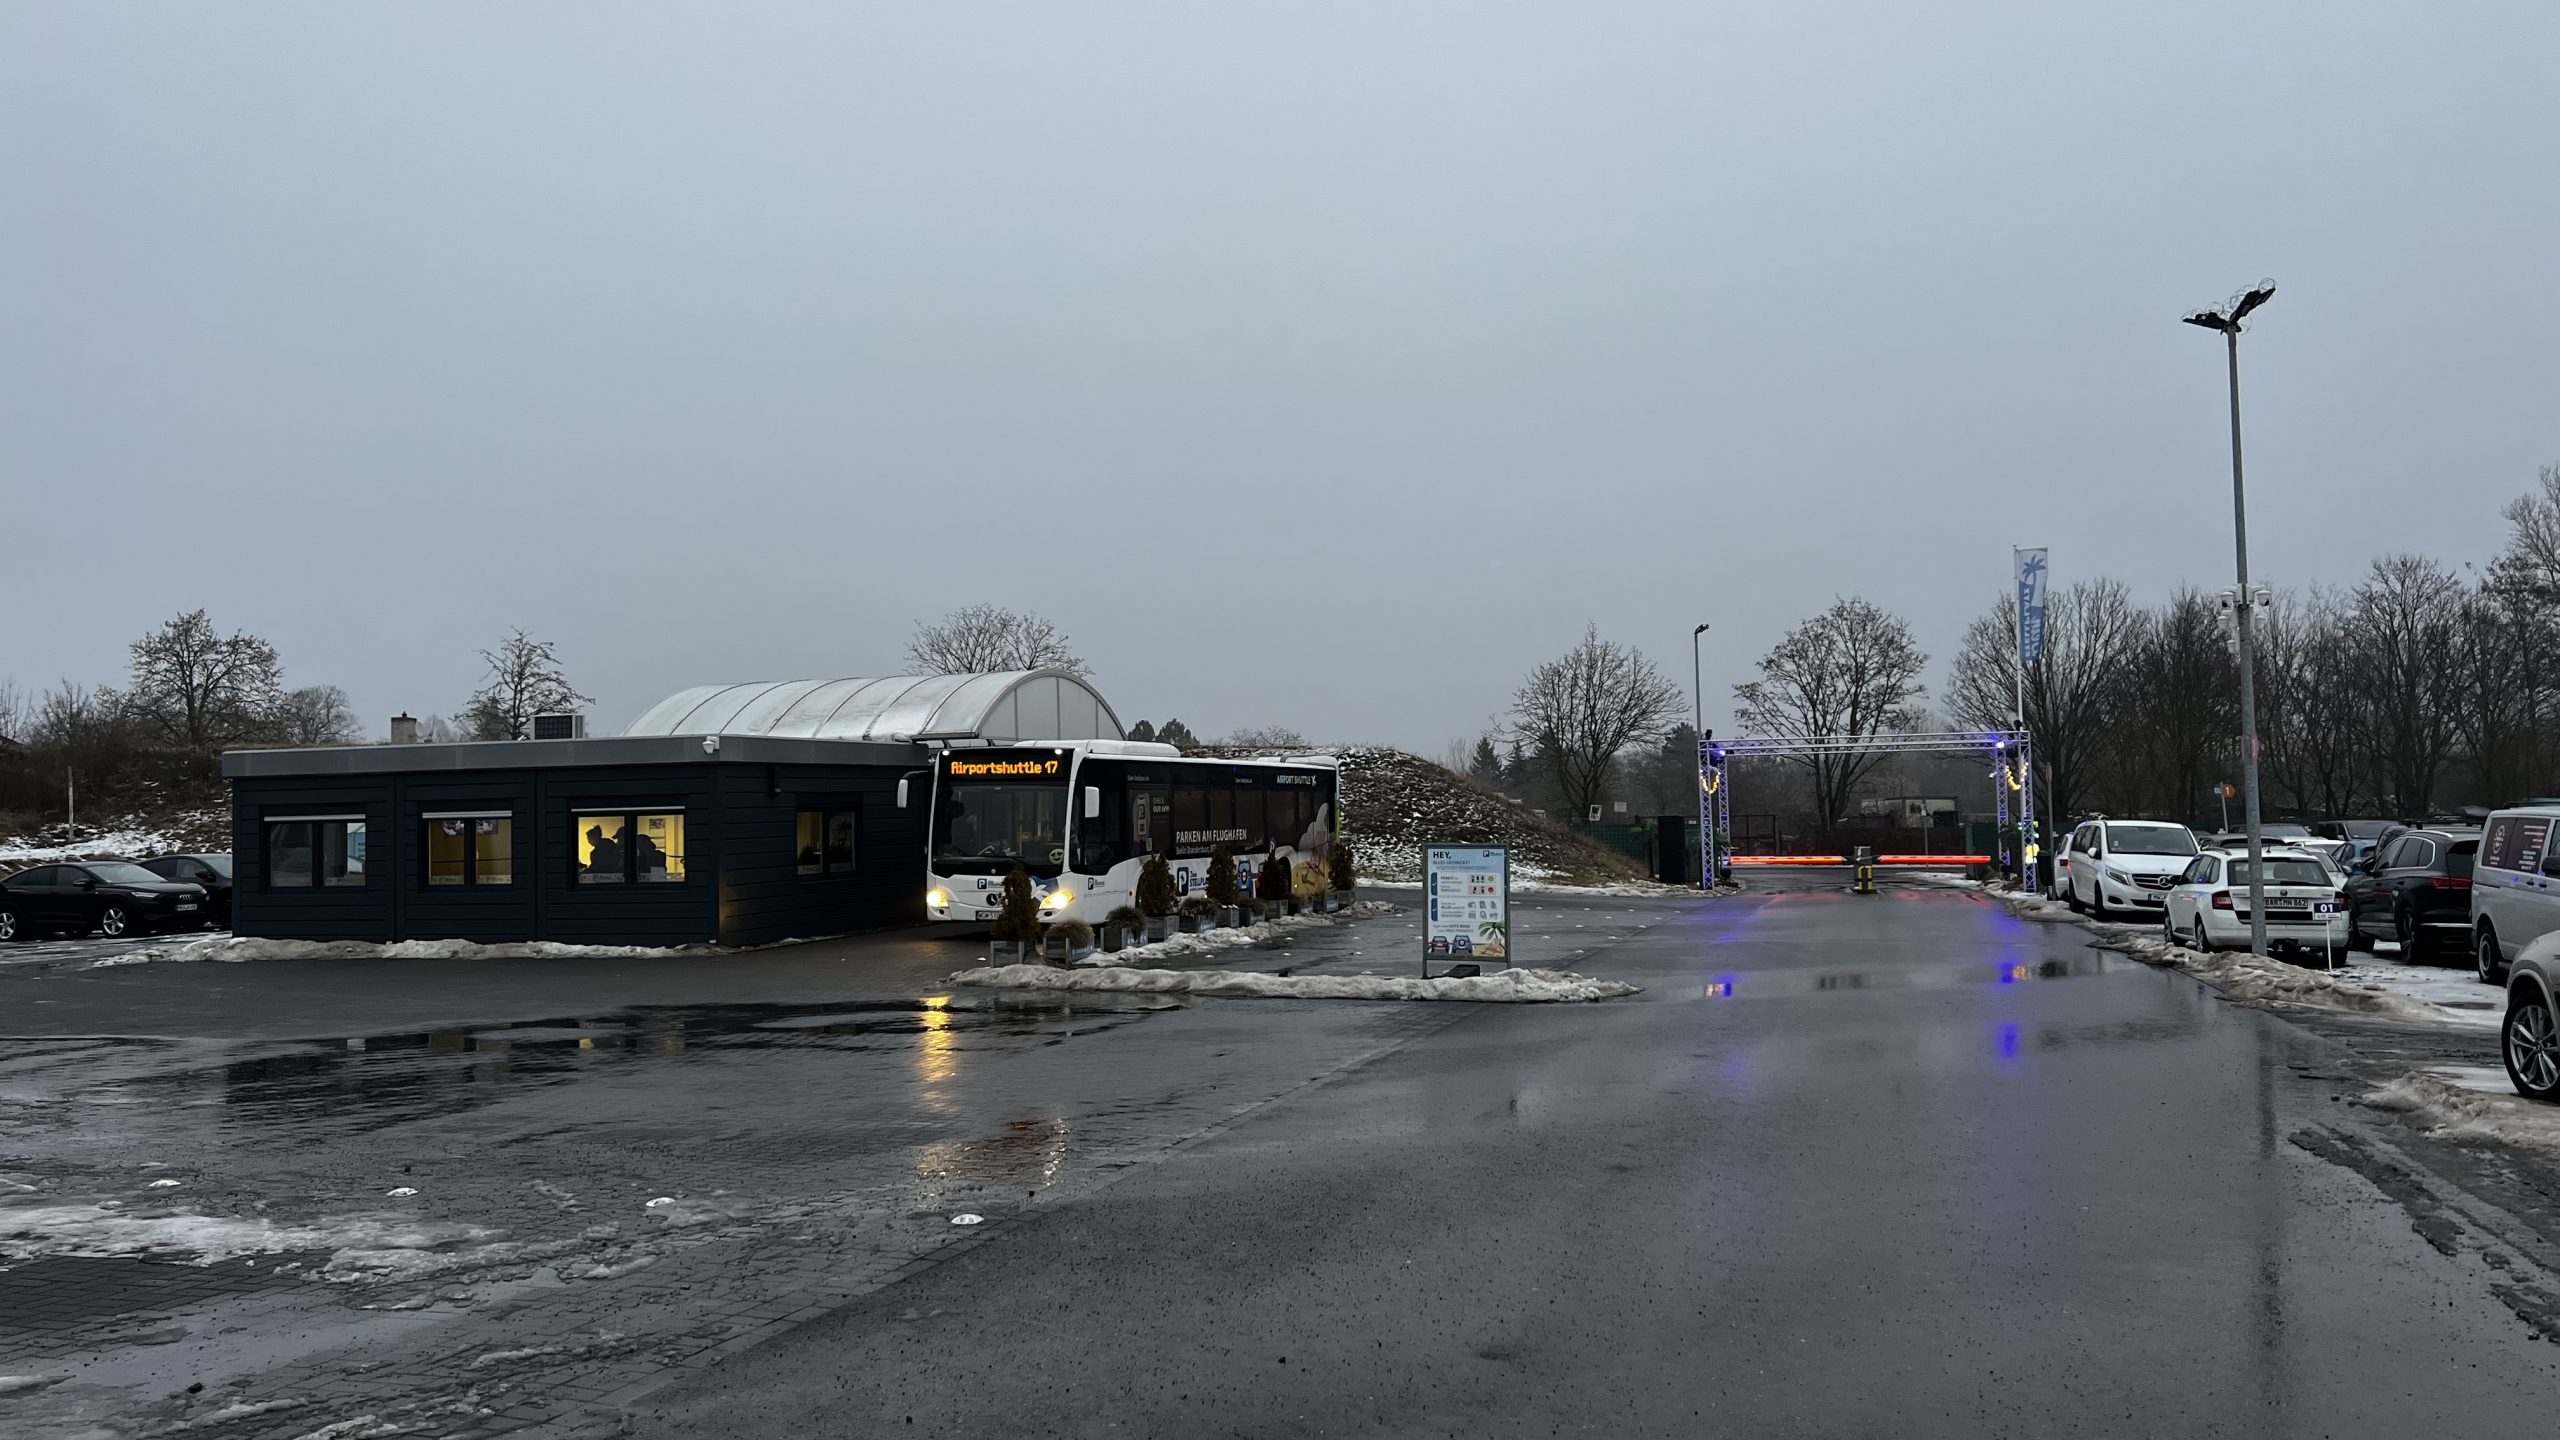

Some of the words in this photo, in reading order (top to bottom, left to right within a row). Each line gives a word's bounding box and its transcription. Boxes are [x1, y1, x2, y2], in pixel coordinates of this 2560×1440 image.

[951, 761, 1042, 775] Airportshuttle
[1045, 761, 1058, 774] 17
[1276, 775, 1294, 784] AIRPORT
[1294, 775, 1311, 784] SHUTTLE
[1176, 830, 1200, 843] PARKEN
[1202, 829, 1212, 842] AM
[1213, 829, 1247, 841] FLUGHAFEN
[1433, 851, 1452, 859] HEY,
[2294, 899, 2307, 907] 862
[2320, 904, 2333, 913] 01
